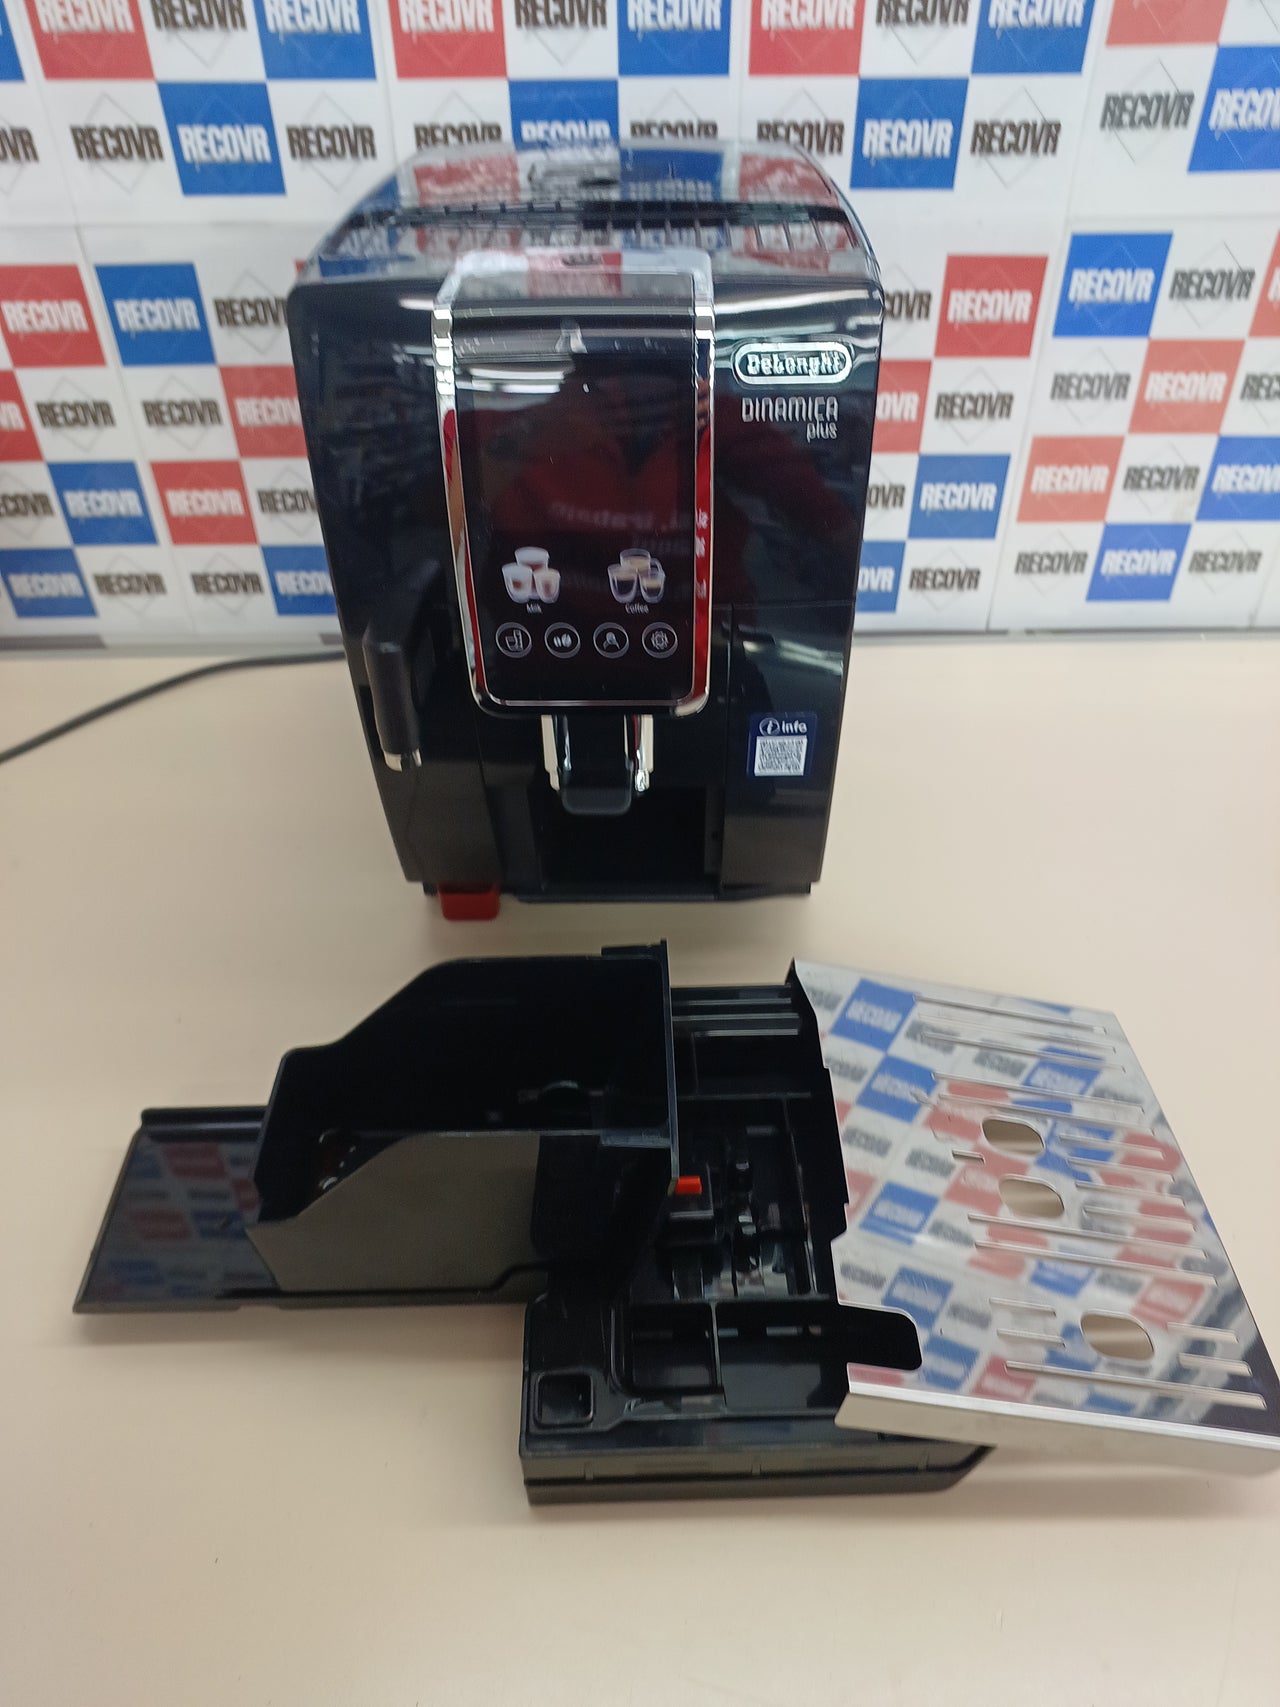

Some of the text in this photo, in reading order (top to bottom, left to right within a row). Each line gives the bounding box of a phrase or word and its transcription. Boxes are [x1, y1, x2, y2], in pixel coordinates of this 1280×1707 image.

[37, 0, 134, 32] RECOVR
[151, 0, 247, 30] RECOVR
[263, 0, 360, 32] RECOVR
[396, 0, 494, 31] RECOVR
[513, 0, 606, 28] RECOVR
[626, 0, 720, 30] RECOVR
[760, 0, 855, 29] RECOVR
[988, 0, 1084, 28] RECOVR
[1100, 91, 1194, 129] RECOVR
[70, 125, 163, 161] RECOVR
[177, 124, 271, 162] RECOVR
[286, 126, 376, 159] RECOVR
[862, 120, 953, 158] RECOVR
[971, 122, 1060, 155] RECOVR
[1069, 269, 1155, 303] RECOVR
[1169, 269, 1255, 301] RECOVR
[0, 300, 89, 332] RECOVR
[114, 300, 200, 331] RECOVR
[947, 291, 1033, 323] RECOVR
[1051, 374, 1131, 401] RECOVR
[1145, 373, 1227, 403] RECOVR
[37, 401, 115, 428] RECOVR
[142, 401, 223, 427] RECOVR
[741, 396, 839, 423] DINAMICA
[936, 395, 1014, 420] RECOVR
[806, 422, 837, 443] plus
[1031, 465, 1109, 493] RECOVR
[1123, 466, 1199, 491] RECOVR
[64, 491, 143, 517] RECOVR
[166, 490, 244, 517] RECOVR
[257, 490, 317, 514] RECOV
[920, 483, 997, 511] RECOVR
[1016, 551, 1088, 575] RECOVR
[1101, 549, 1177, 576] RECOVR
[1189, 550, 1261, 574] RECOVR
[93, 573, 167, 595] RECOVR
[191, 573, 264, 595] RECOVR
[274, 571, 334, 595] RECOV
[910, 568, 981, 591] RECOVR
[625, 603, 650, 614] Coffee
